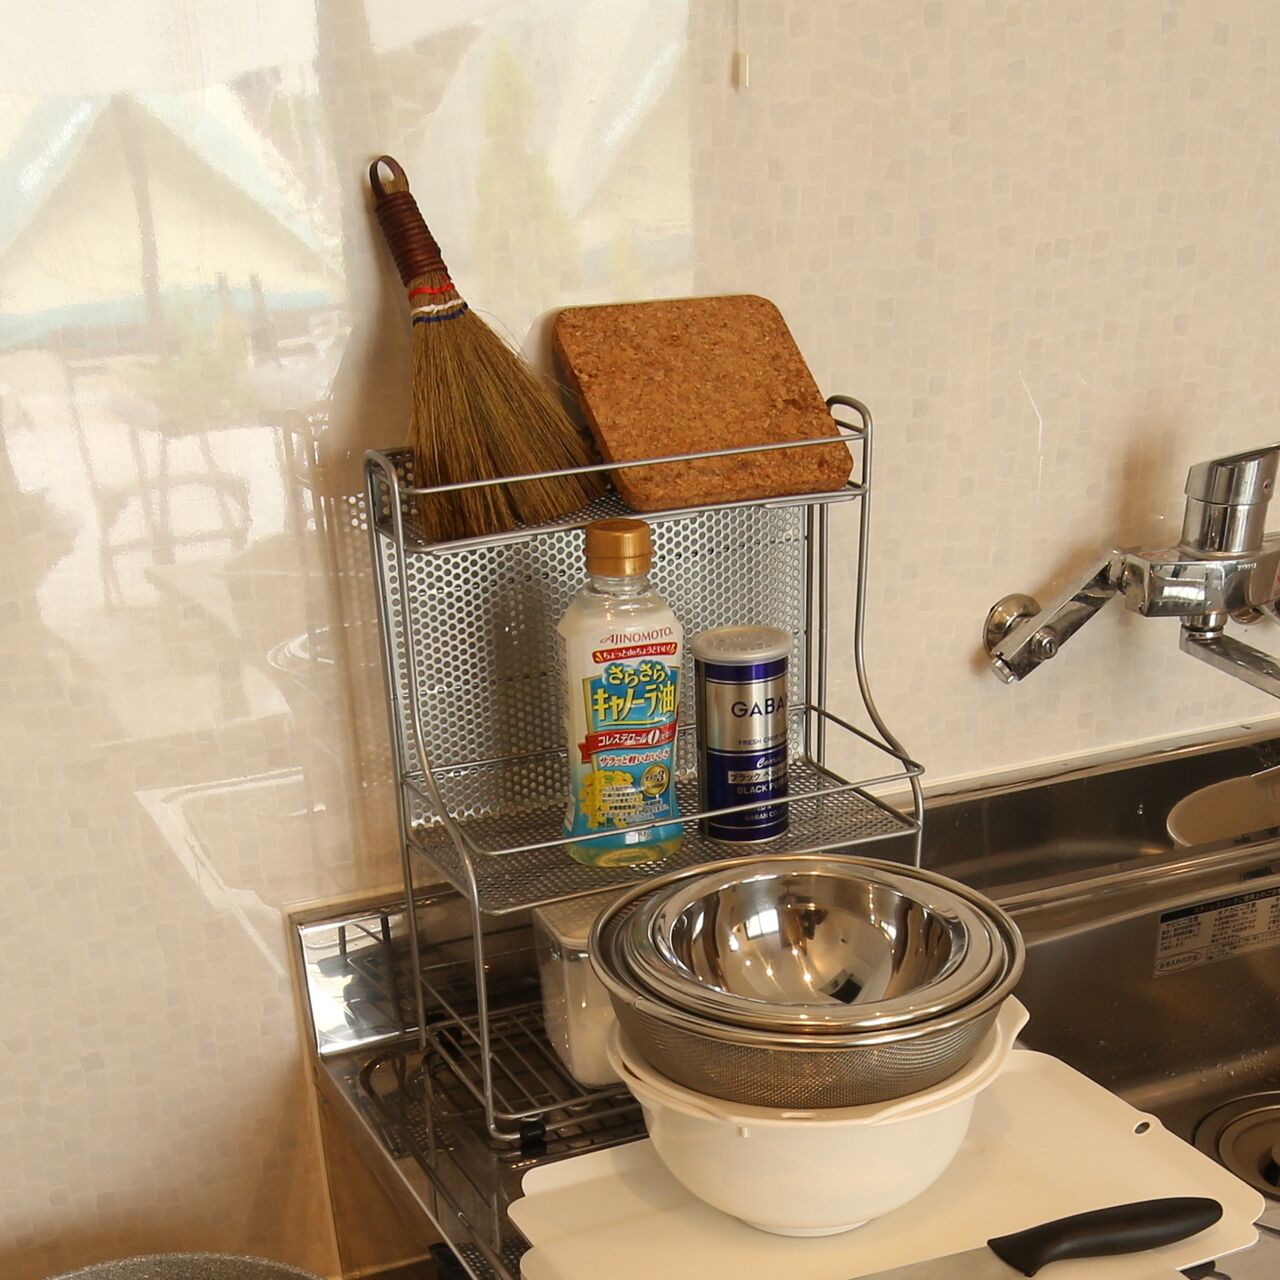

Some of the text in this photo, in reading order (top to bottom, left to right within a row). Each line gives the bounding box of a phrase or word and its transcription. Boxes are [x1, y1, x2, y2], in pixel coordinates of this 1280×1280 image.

[600, 627, 671, 645] AJINOMOTO
[609, 663, 666, 687] さらさら
[593, 681, 675, 720] キャノーラ油
[731, 696, 787, 718] GABA
[737, 784, 768, 795] BLACK
